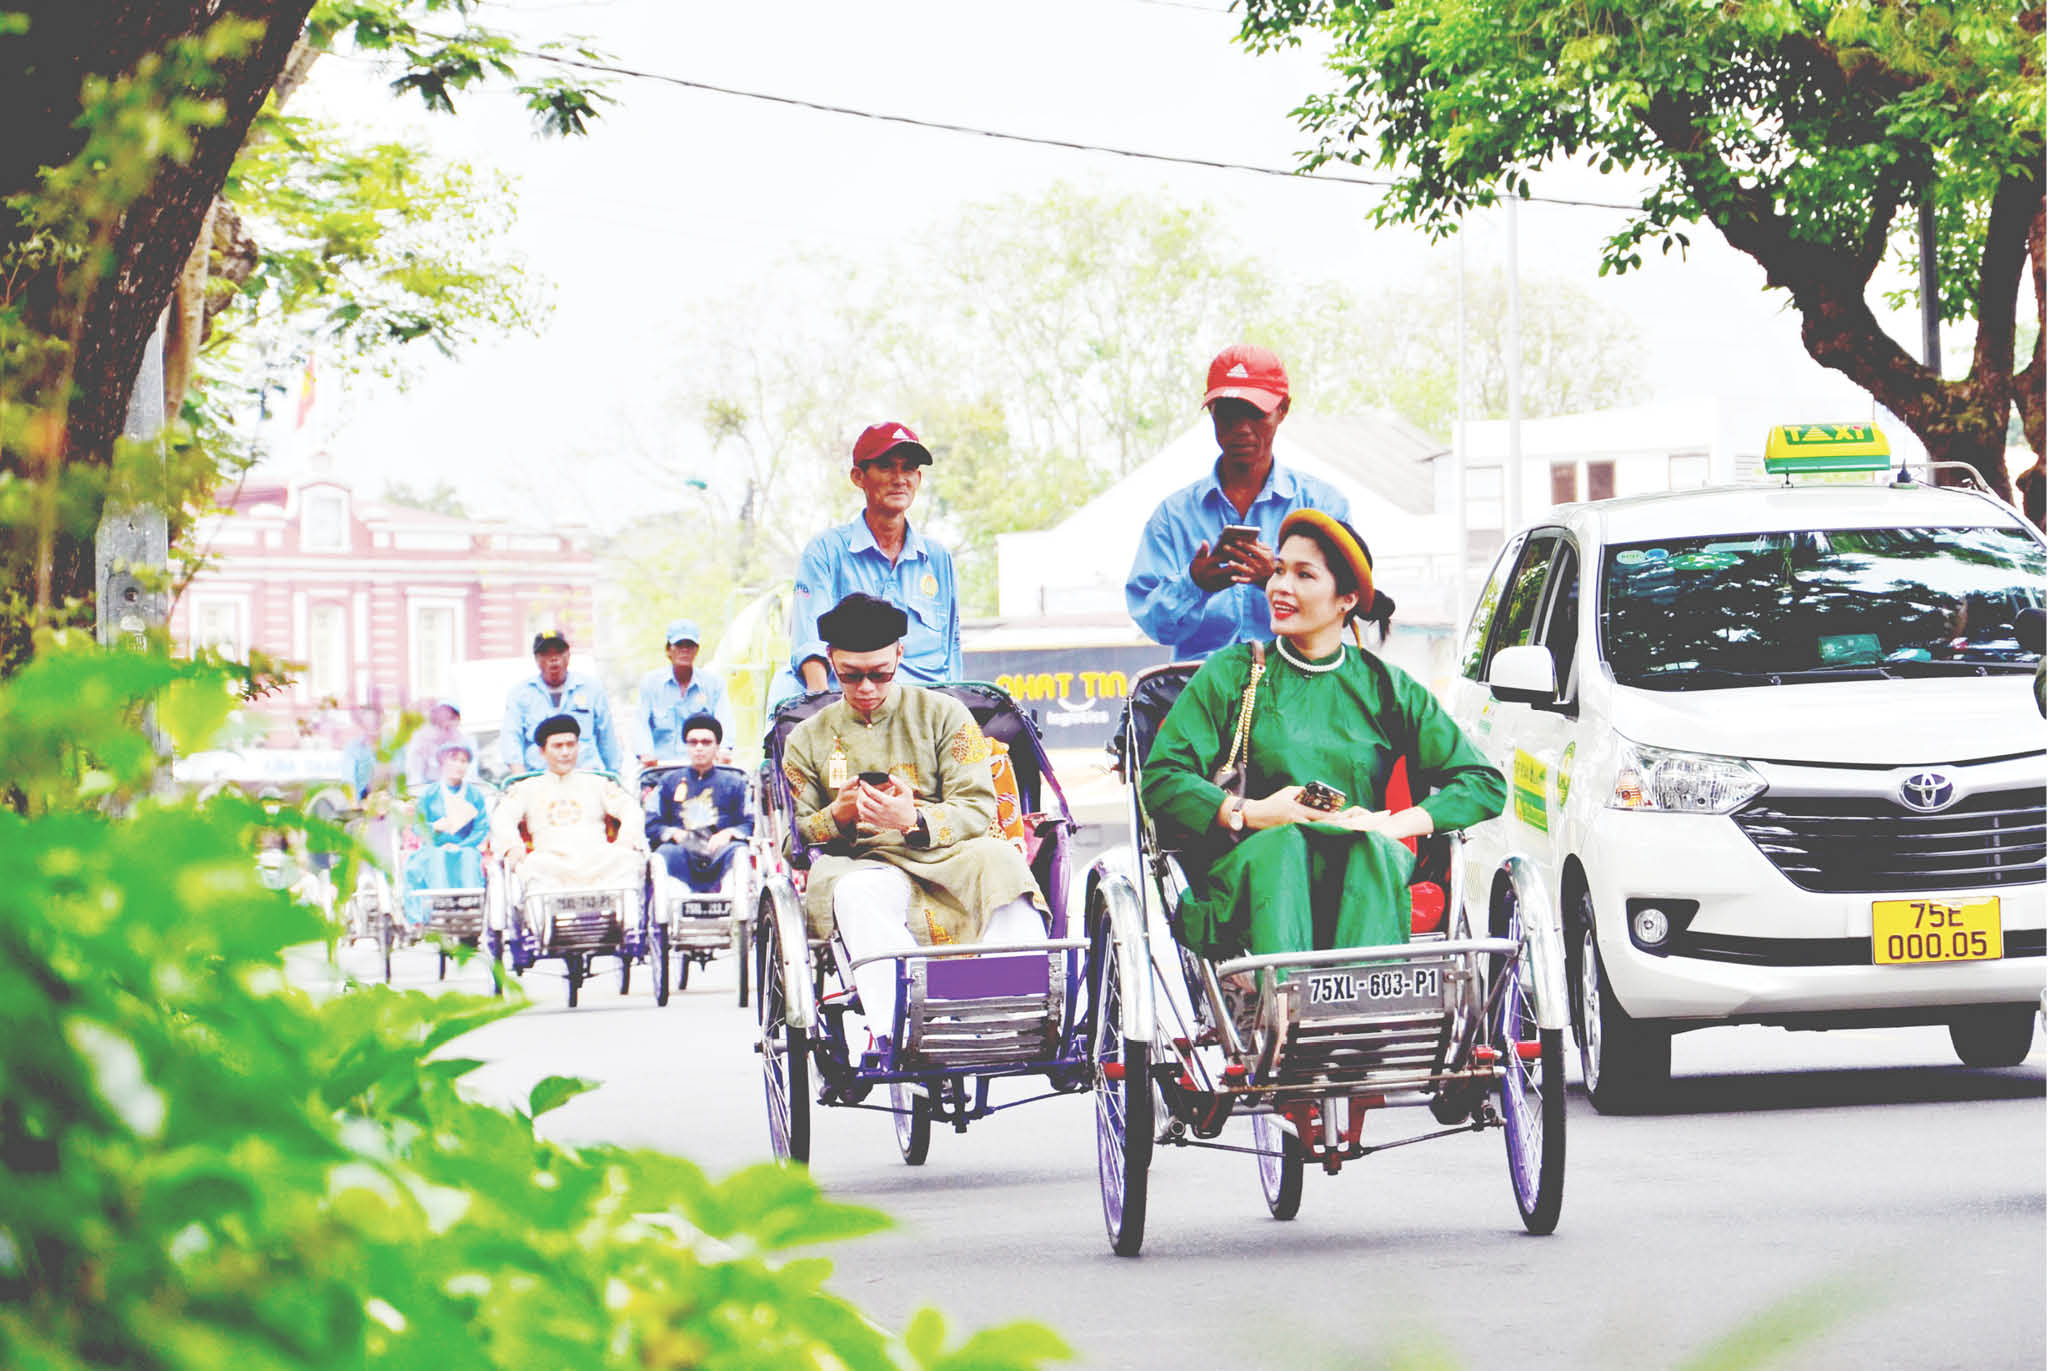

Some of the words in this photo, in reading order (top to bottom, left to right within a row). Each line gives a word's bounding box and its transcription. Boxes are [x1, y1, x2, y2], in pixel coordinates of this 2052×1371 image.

[1079, 671, 1127, 698] TIN
[1910, 903, 1964, 928] 75E
[1888, 931, 1987, 960] 000.05
